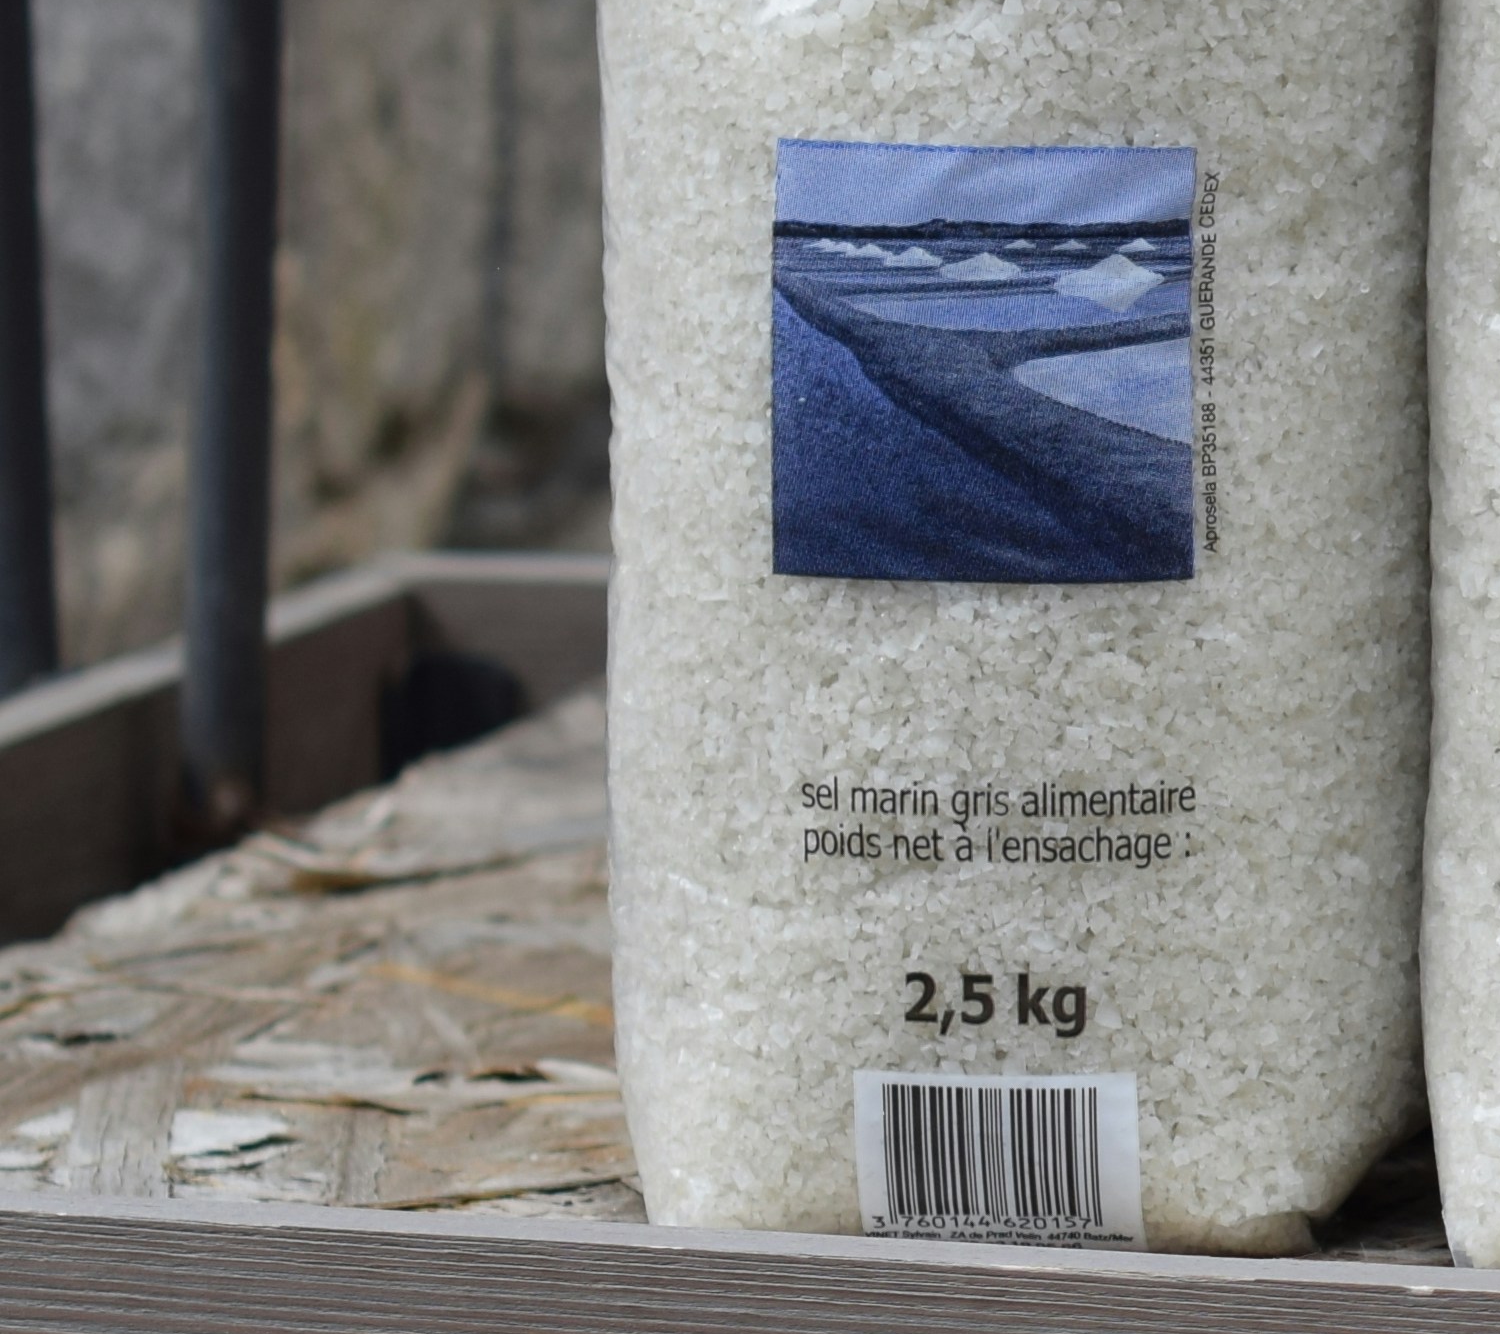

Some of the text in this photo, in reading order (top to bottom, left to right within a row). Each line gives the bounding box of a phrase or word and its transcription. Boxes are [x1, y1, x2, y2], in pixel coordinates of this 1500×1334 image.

[1201, 170, 1221, 229] CEDEX
[1200, 232, 1218, 331] GUERANDE
[1200, 334, 1216, 386] 44351
[1203, 481, 1219, 553] Aprosela
[801, 777, 1196, 824] sel marin gris alimentaire
[803, 824, 1172, 867] poids net à l'ensachage
[904, 972, 1087, 1038] 2,5 kg
[872, 1216, 1092, 1230] 3 760144 620157
